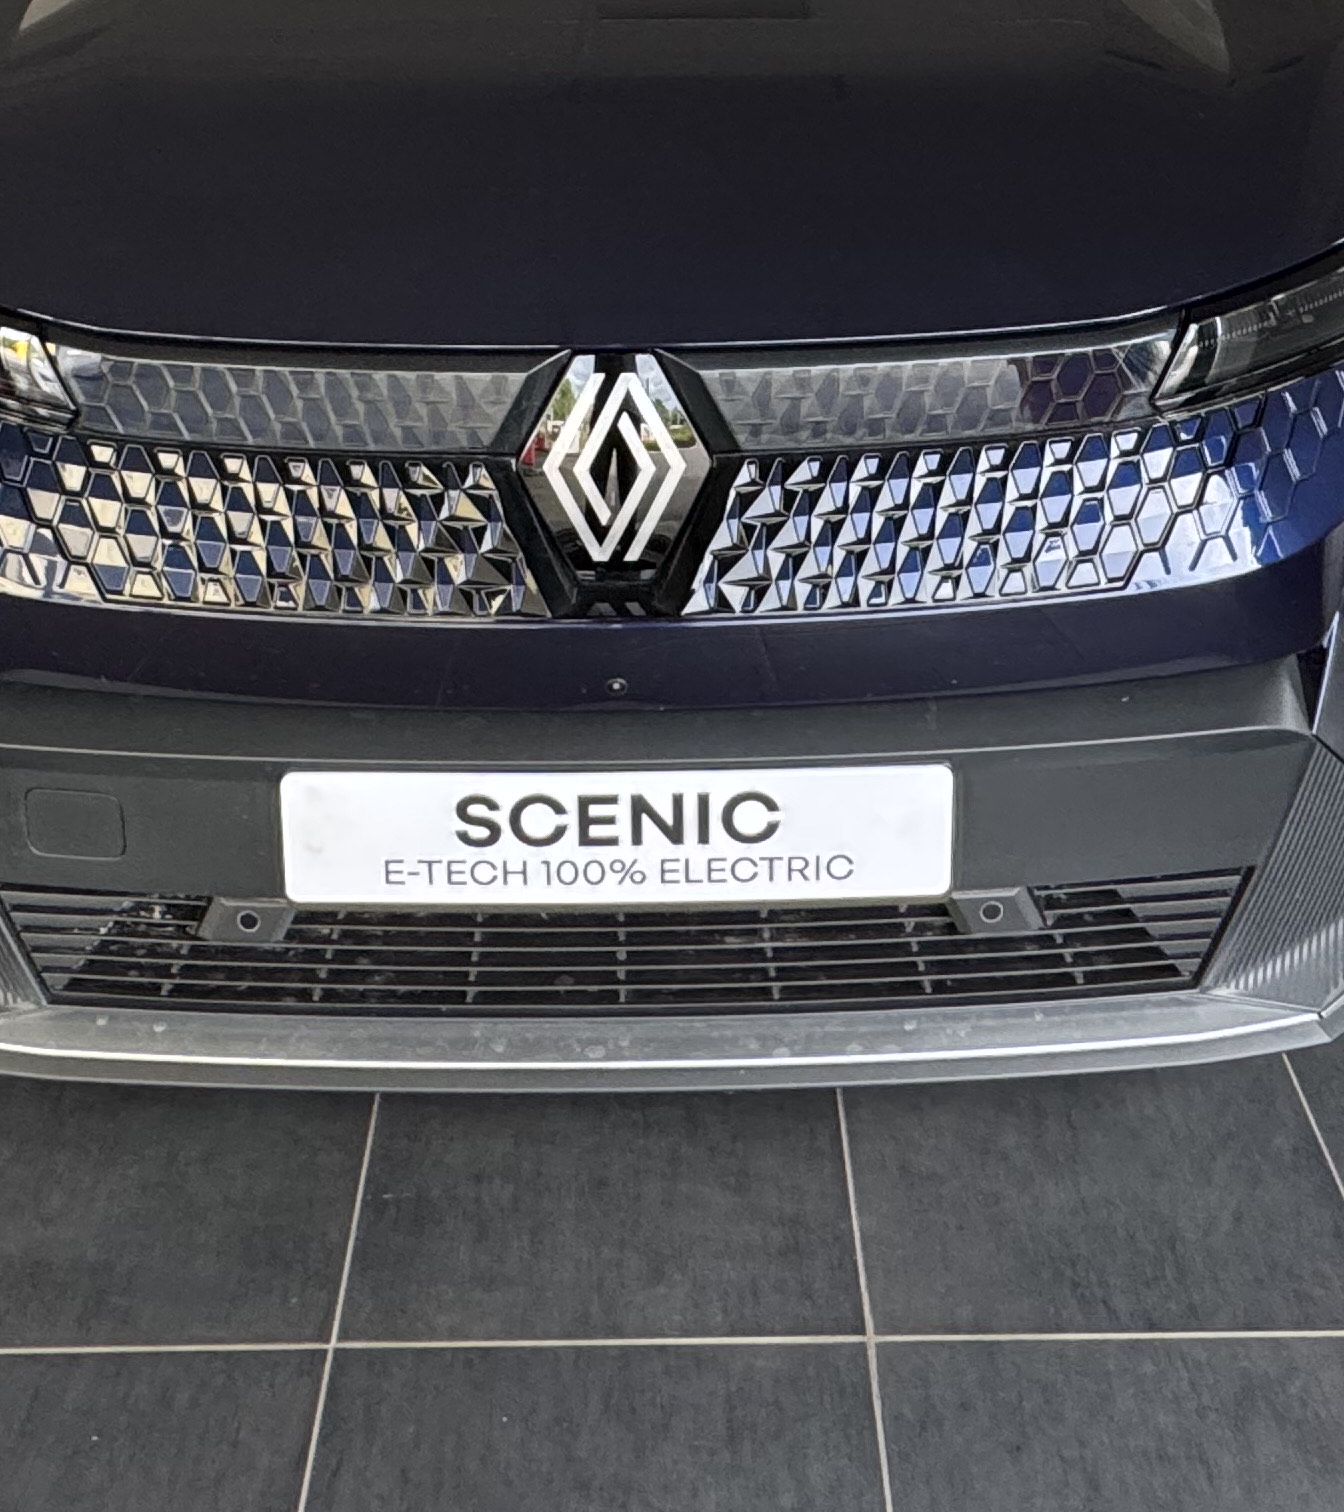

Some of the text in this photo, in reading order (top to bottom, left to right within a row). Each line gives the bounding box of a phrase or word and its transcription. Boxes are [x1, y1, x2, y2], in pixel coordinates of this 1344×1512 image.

[454, 790, 782, 849] SCENIC
[383, 853, 855, 887] E-TECH 100% ELECTRIC
